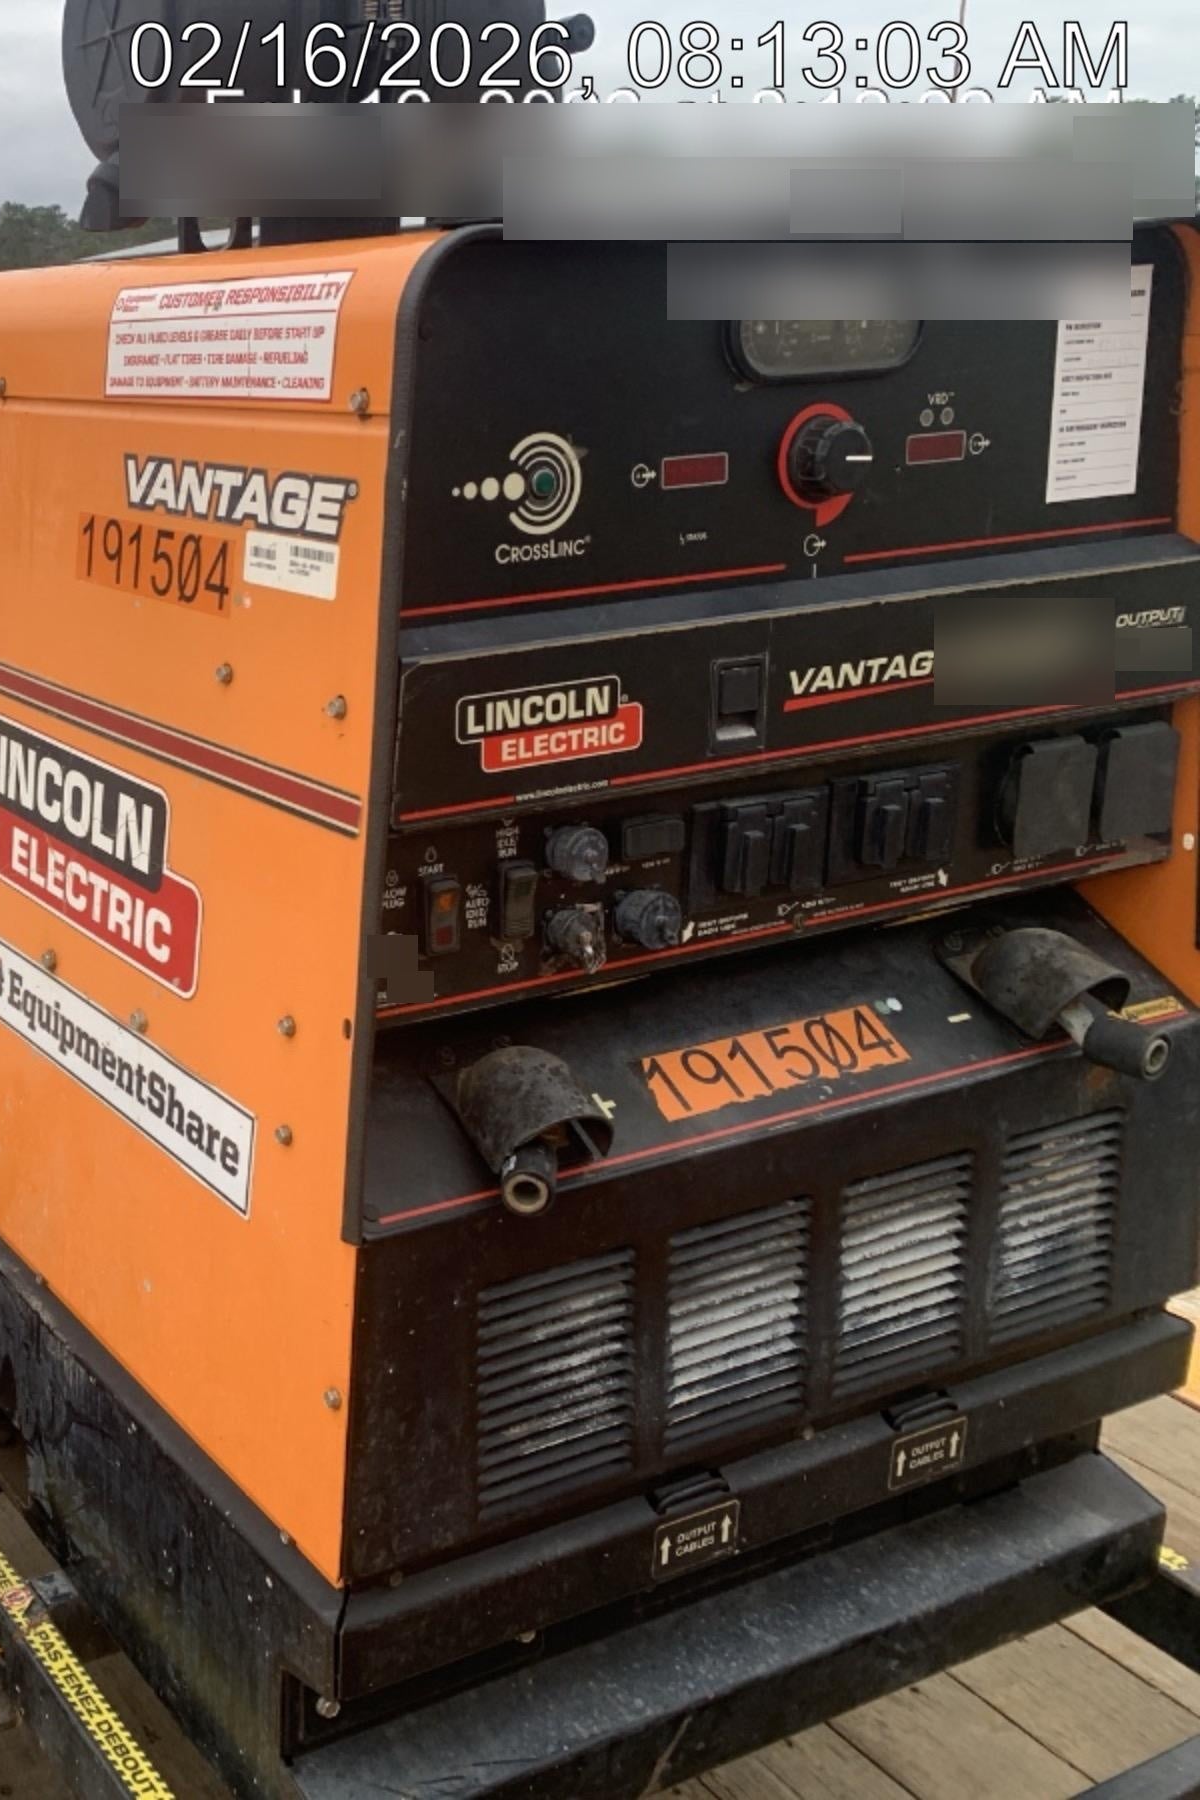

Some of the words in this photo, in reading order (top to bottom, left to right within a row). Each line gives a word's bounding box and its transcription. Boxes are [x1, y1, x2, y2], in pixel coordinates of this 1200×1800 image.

[158, 289, 225, 311] CUSTOMER
[226, 282, 345, 305] RESPONSIBILITY
[285, 326, 311, 339] START
[125, 456, 349, 539] VANTAGE
[81, 514, 230, 611] 191504
[788, 650, 934, 695] VANTAG
[467, 685, 611, 735] LINCOLN
[501, 722, 626, 762] ELECTRIC
[11, 826, 172, 964] ELECTRIC
[7, 967, 240, 1179] EquipmentShare
[645, 1009, 899, 1112] 191504
[909, 1450, 945, 1470] CABLES
[911, 1436, 947, 1457] OUTPUT
[675, 1535, 716, 1558] CABLES
[677, 1522, 716, 1544] OUTPUT
[35, 1630, 63, 1663] PAS
[59, 1662, 103, 1719] TENEZ
[95, 1719, 158, 1794] DEBOUT
